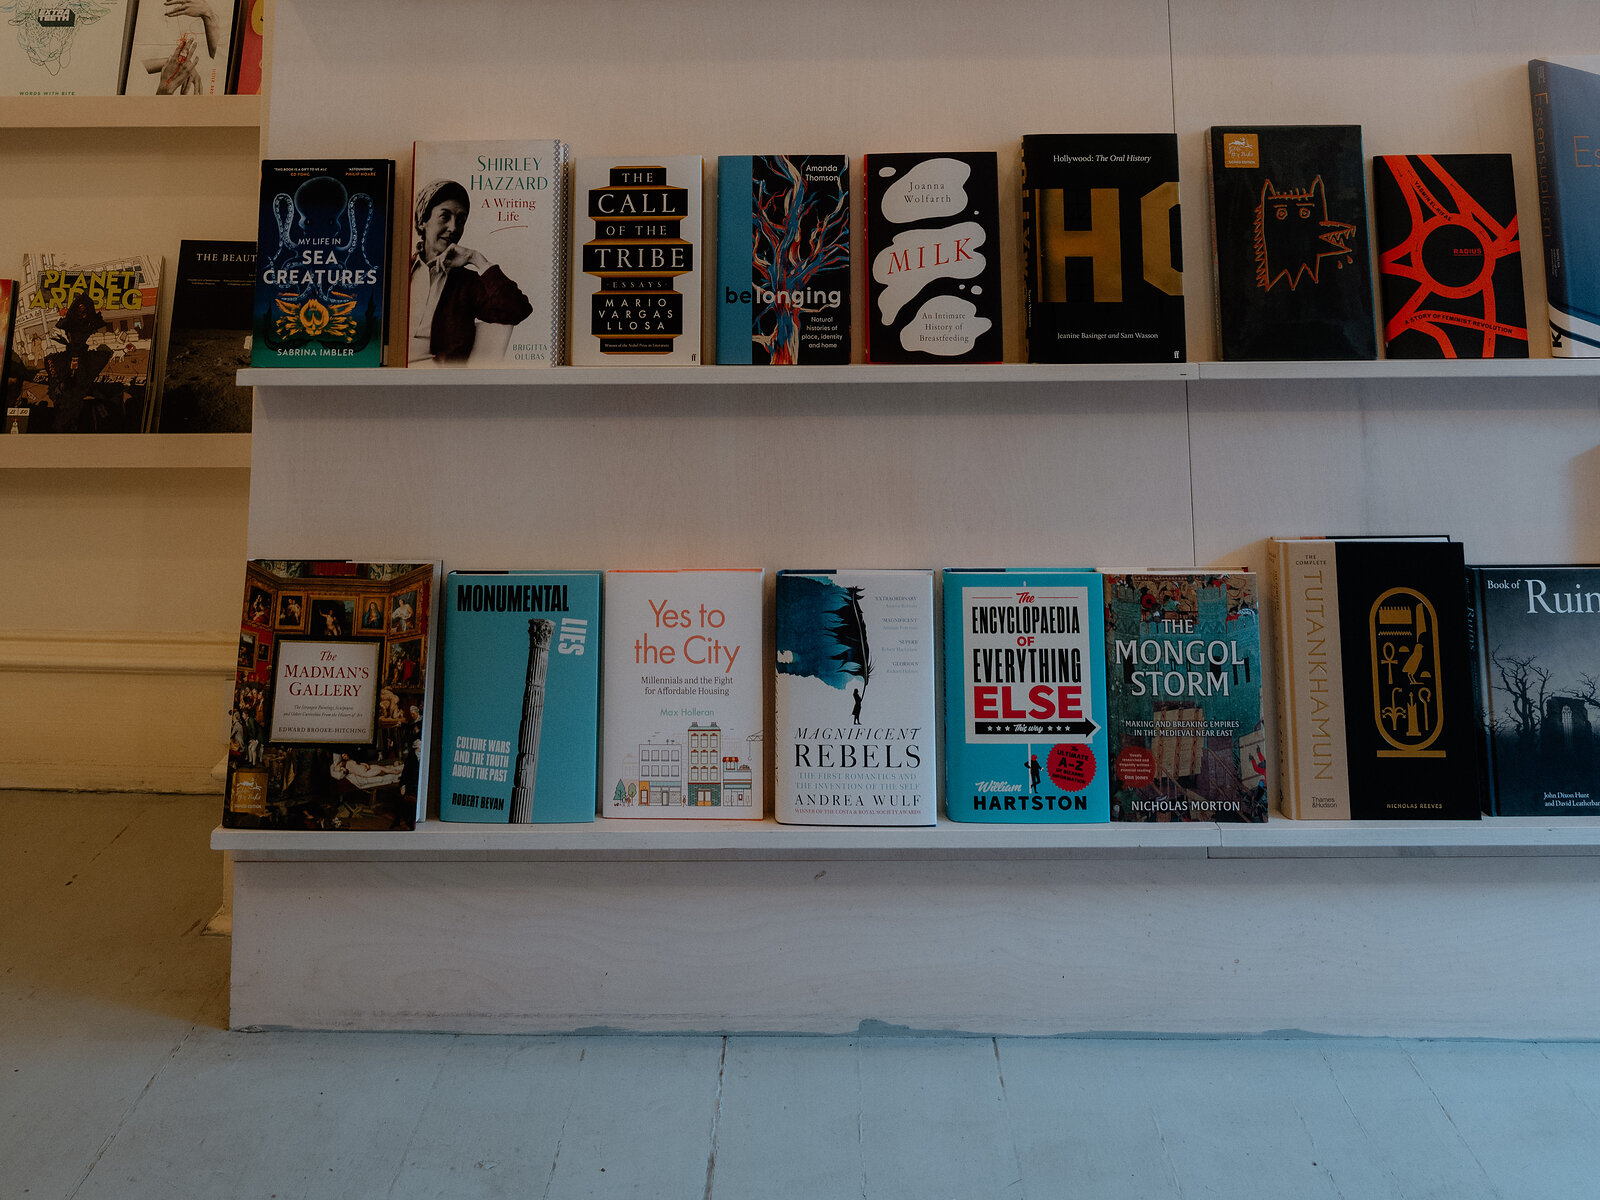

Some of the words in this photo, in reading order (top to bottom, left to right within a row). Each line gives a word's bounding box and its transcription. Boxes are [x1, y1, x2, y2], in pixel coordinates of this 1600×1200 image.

[477, 155, 542, 172] SHIRLEY
[1053, 155, 1094, 163] Hollywood:
[1127, 154, 1151, 163] History
[470, 174, 548, 191] HAZZARD
[908, 182, 945, 192] Joanna
[598, 194, 676, 213] CALL
[904, 194, 951, 204] Wolfarth
[302, 251, 338, 264] SEA
[595, 249, 685, 268] TRIBE
[887, 238, 973, 275] MILK
[44, 270, 134, 289] PLANET
[263, 270, 377, 284] CREATURES
[725, 286, 841, 308] belonging
[1487, 580, 1509, 589] Book
[1511, 579, 1520, 589] of
[457, 584, 569, 612] MONUMENTAL
[648, 599, 692, 628] Yes
[699, 603, 725, 628] to
[972, 606, 1080, 634] ENCYCLOPAEDIA
[558, 618, 588, 656] LIES
[634, 633, 675, 664] the
[683, 634, 740, 673] City
[1115, 640, 1244, 665] MONGOL
[284, 665, 369, 679] MADMAN'S
[974, 648, 1081, 683] EVERYTHING
[641, 676, 682, 684] Millennials
[700, 676, 712, 684] the
[714, 676, 733, 686] Fight
[1131, 671, 1230, 697] STORM
[1303, 570, 1332, 781] TUTANKHAMUN
[289, 683, 362, 698] GALLERY
[974, 685, 1082, 720] ELSE
[795, 744, 921, 768] REBELS
[975, 781, 1022, 793] William
[452, 793, 479, 807] ROBERT
[481, 796, 504, 810] BEVAN
[974, 796, 1087, 811] HARTSTON
[1131, 800, 1188, 811] NICHOLAS
[1191, 801, 1240, 811] MORTON
